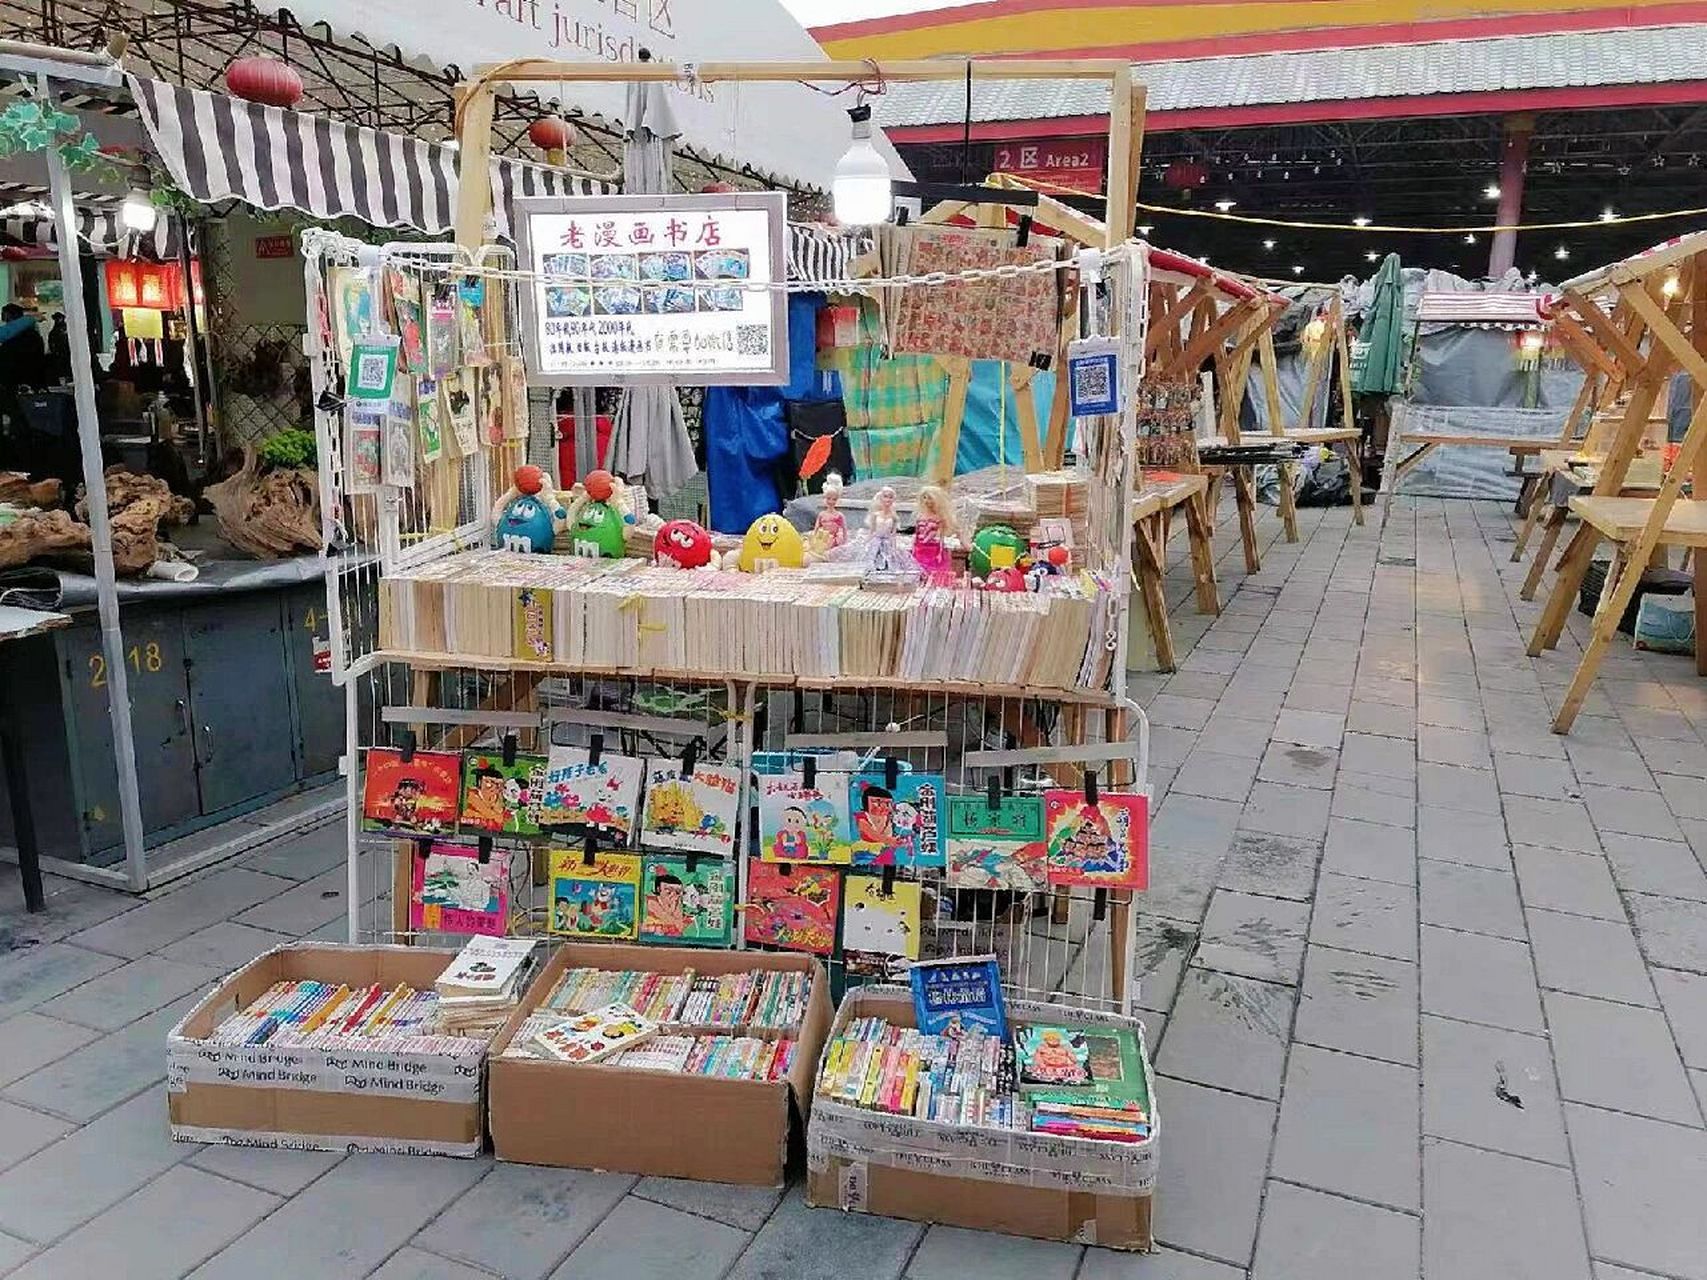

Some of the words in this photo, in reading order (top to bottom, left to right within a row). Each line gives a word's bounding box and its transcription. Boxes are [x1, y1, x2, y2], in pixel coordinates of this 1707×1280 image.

[1046, 153, 1089, 167] Area2
[560, 215, 721, 248] 老漫画书店
[654, 329, 734, 353] 有需要加微信
[351, 1059, 384, 1070] Mind
[387, 1061, 427, 1075] Bridge
[242, 1070, 275, 1081] Mind
[278, 1070, 317, 1087] Bridge
[370, 1078, 404, 1090] Mind
[406, 1079, 446, 1096] Bridge
